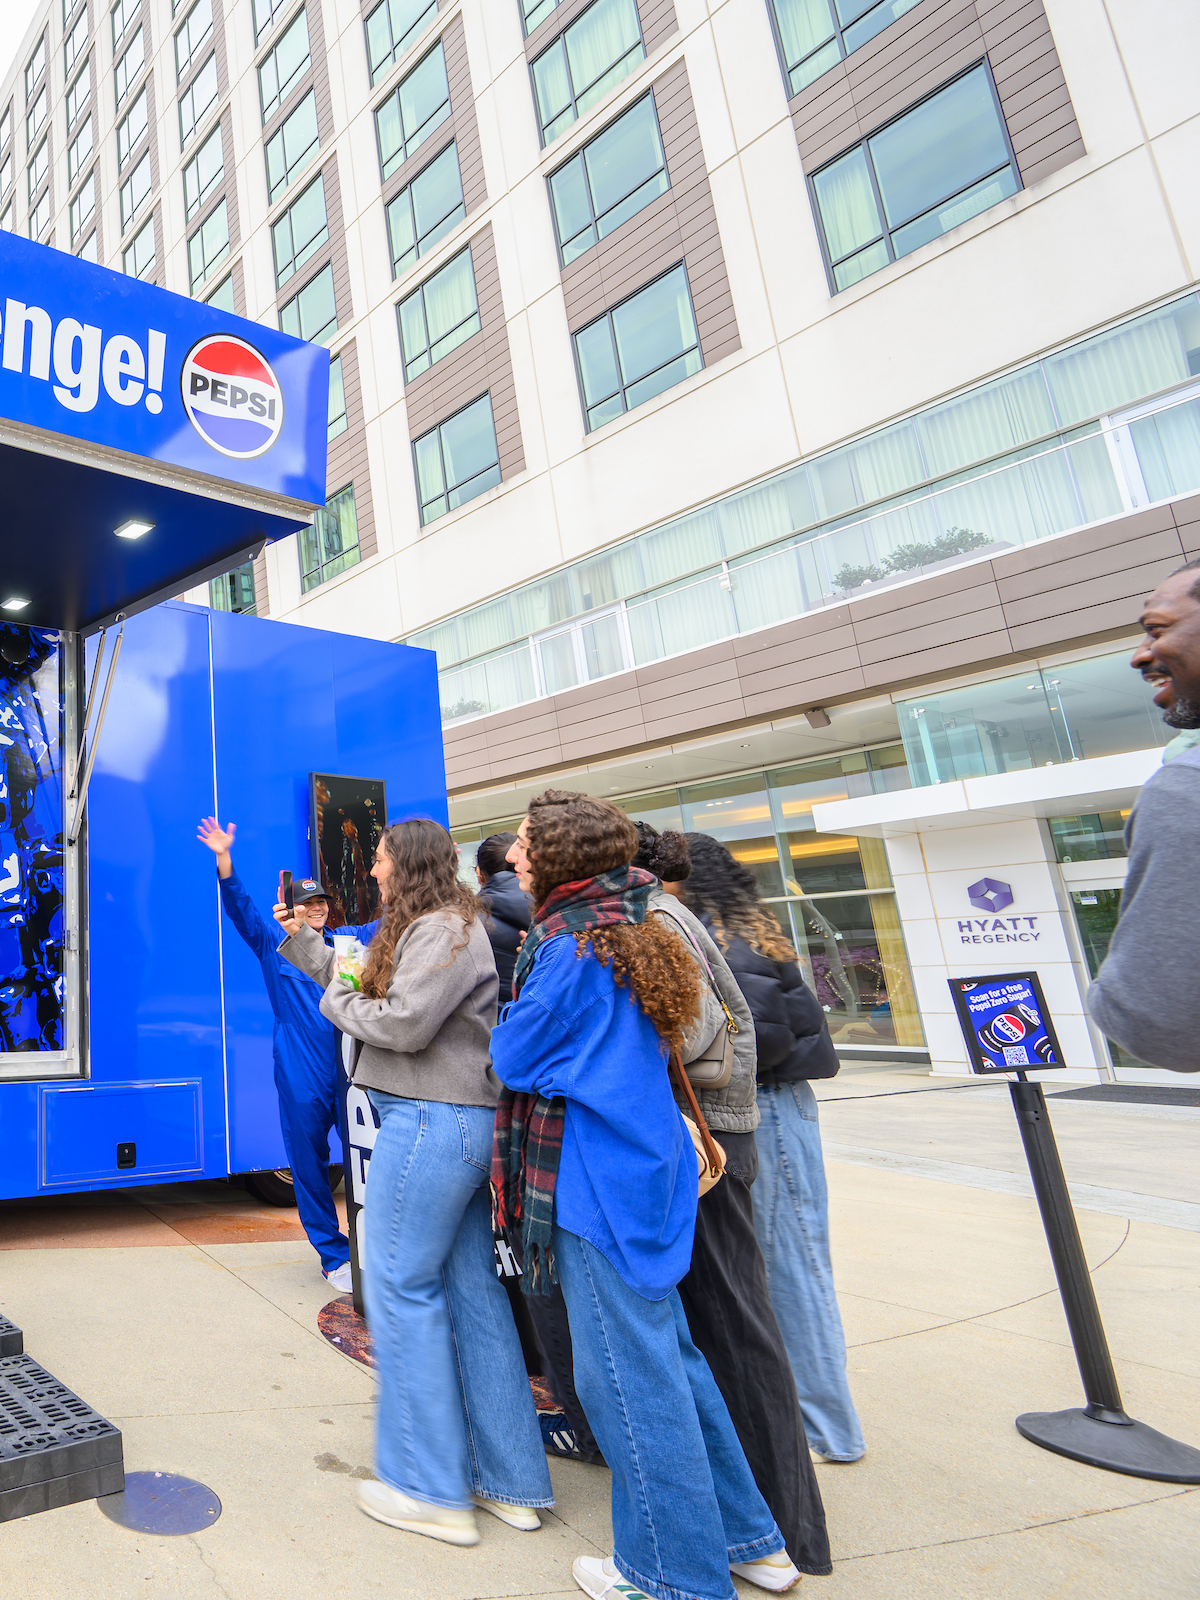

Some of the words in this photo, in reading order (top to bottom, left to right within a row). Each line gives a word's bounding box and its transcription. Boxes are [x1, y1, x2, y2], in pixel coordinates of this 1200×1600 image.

[189, 371, 277, 421] PEPSI
[957, 917, 1038, 932] HYATT
[960, 932, 1040, 944] REGENCY
[968, 1000, 991, 1013] Pepsi
[990, 997, 1008, 1007] Zero
[1006, 988, 1032, 1001] Sugar!
[969, 992, 990, 1004] Scan
[988, 989, 1000, 998] for
[1005, 983, 1023, 993] free
[997, 1017, 1021, 1040] PEPSI
